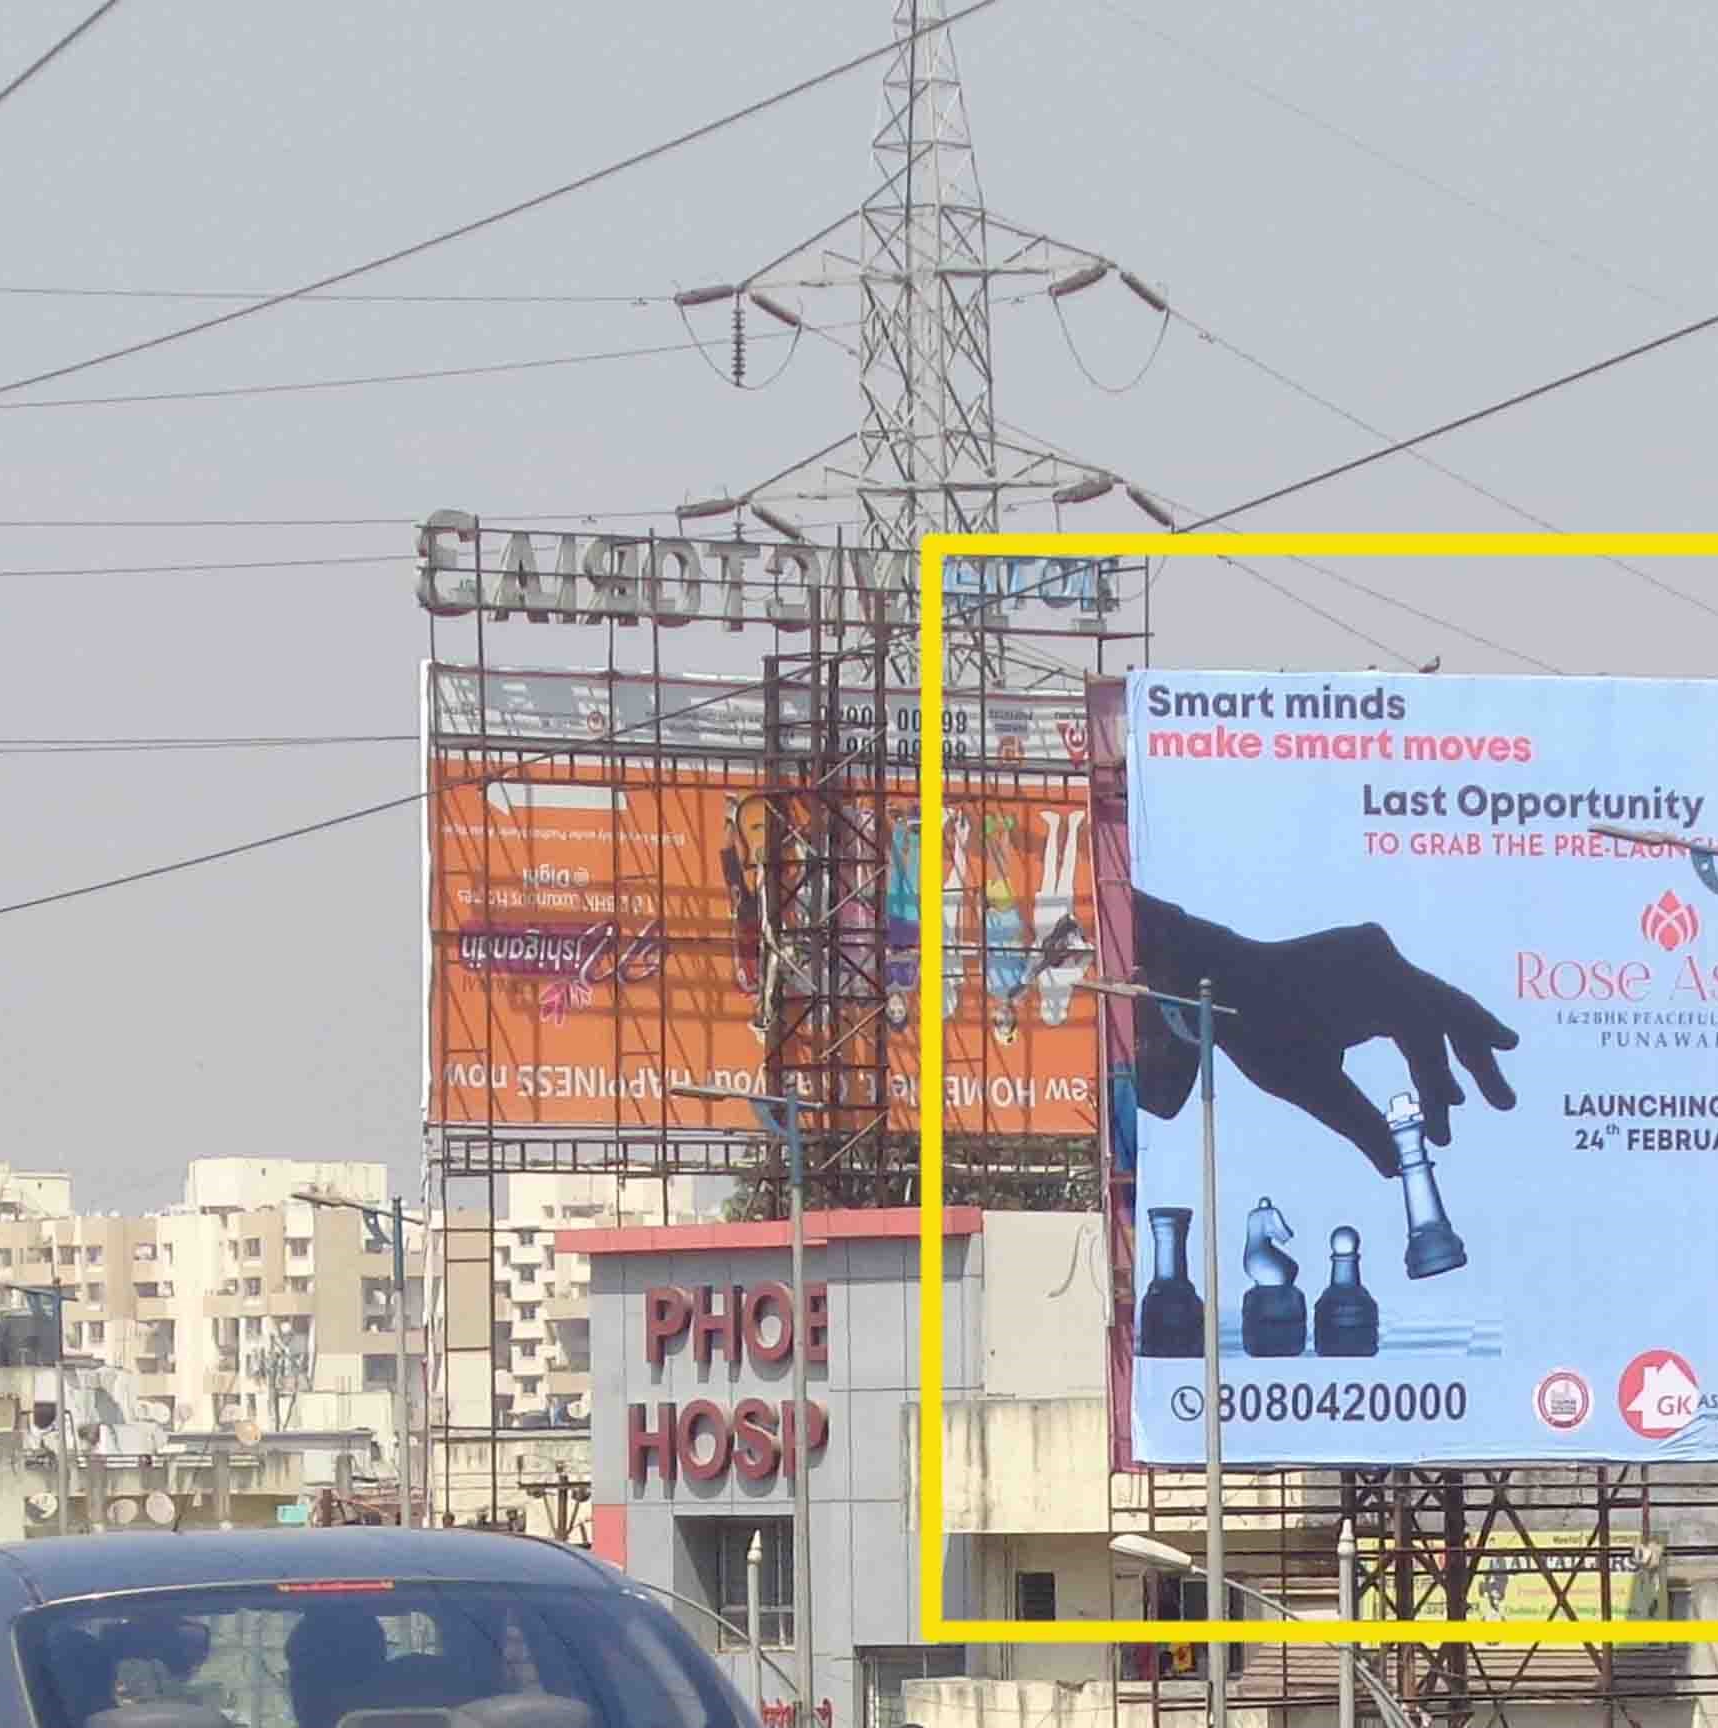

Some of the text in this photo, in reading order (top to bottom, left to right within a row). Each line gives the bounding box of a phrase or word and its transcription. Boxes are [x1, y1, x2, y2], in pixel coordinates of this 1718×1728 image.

[1148, 685, 1405, 719] Smart minds
[1148, 726, 1532, 762] make smart moves
[1363, 784, 1705, 828] Last Opportunity
[1363, 832, 1399, 855] TO
[1410, 832, 1482, 856] GRAB
[1492, 833, 1544, 857] THE
[1516, 951, 1651, 1002] Rose
[1219, 1382, 1467, 1422] 8080420000
